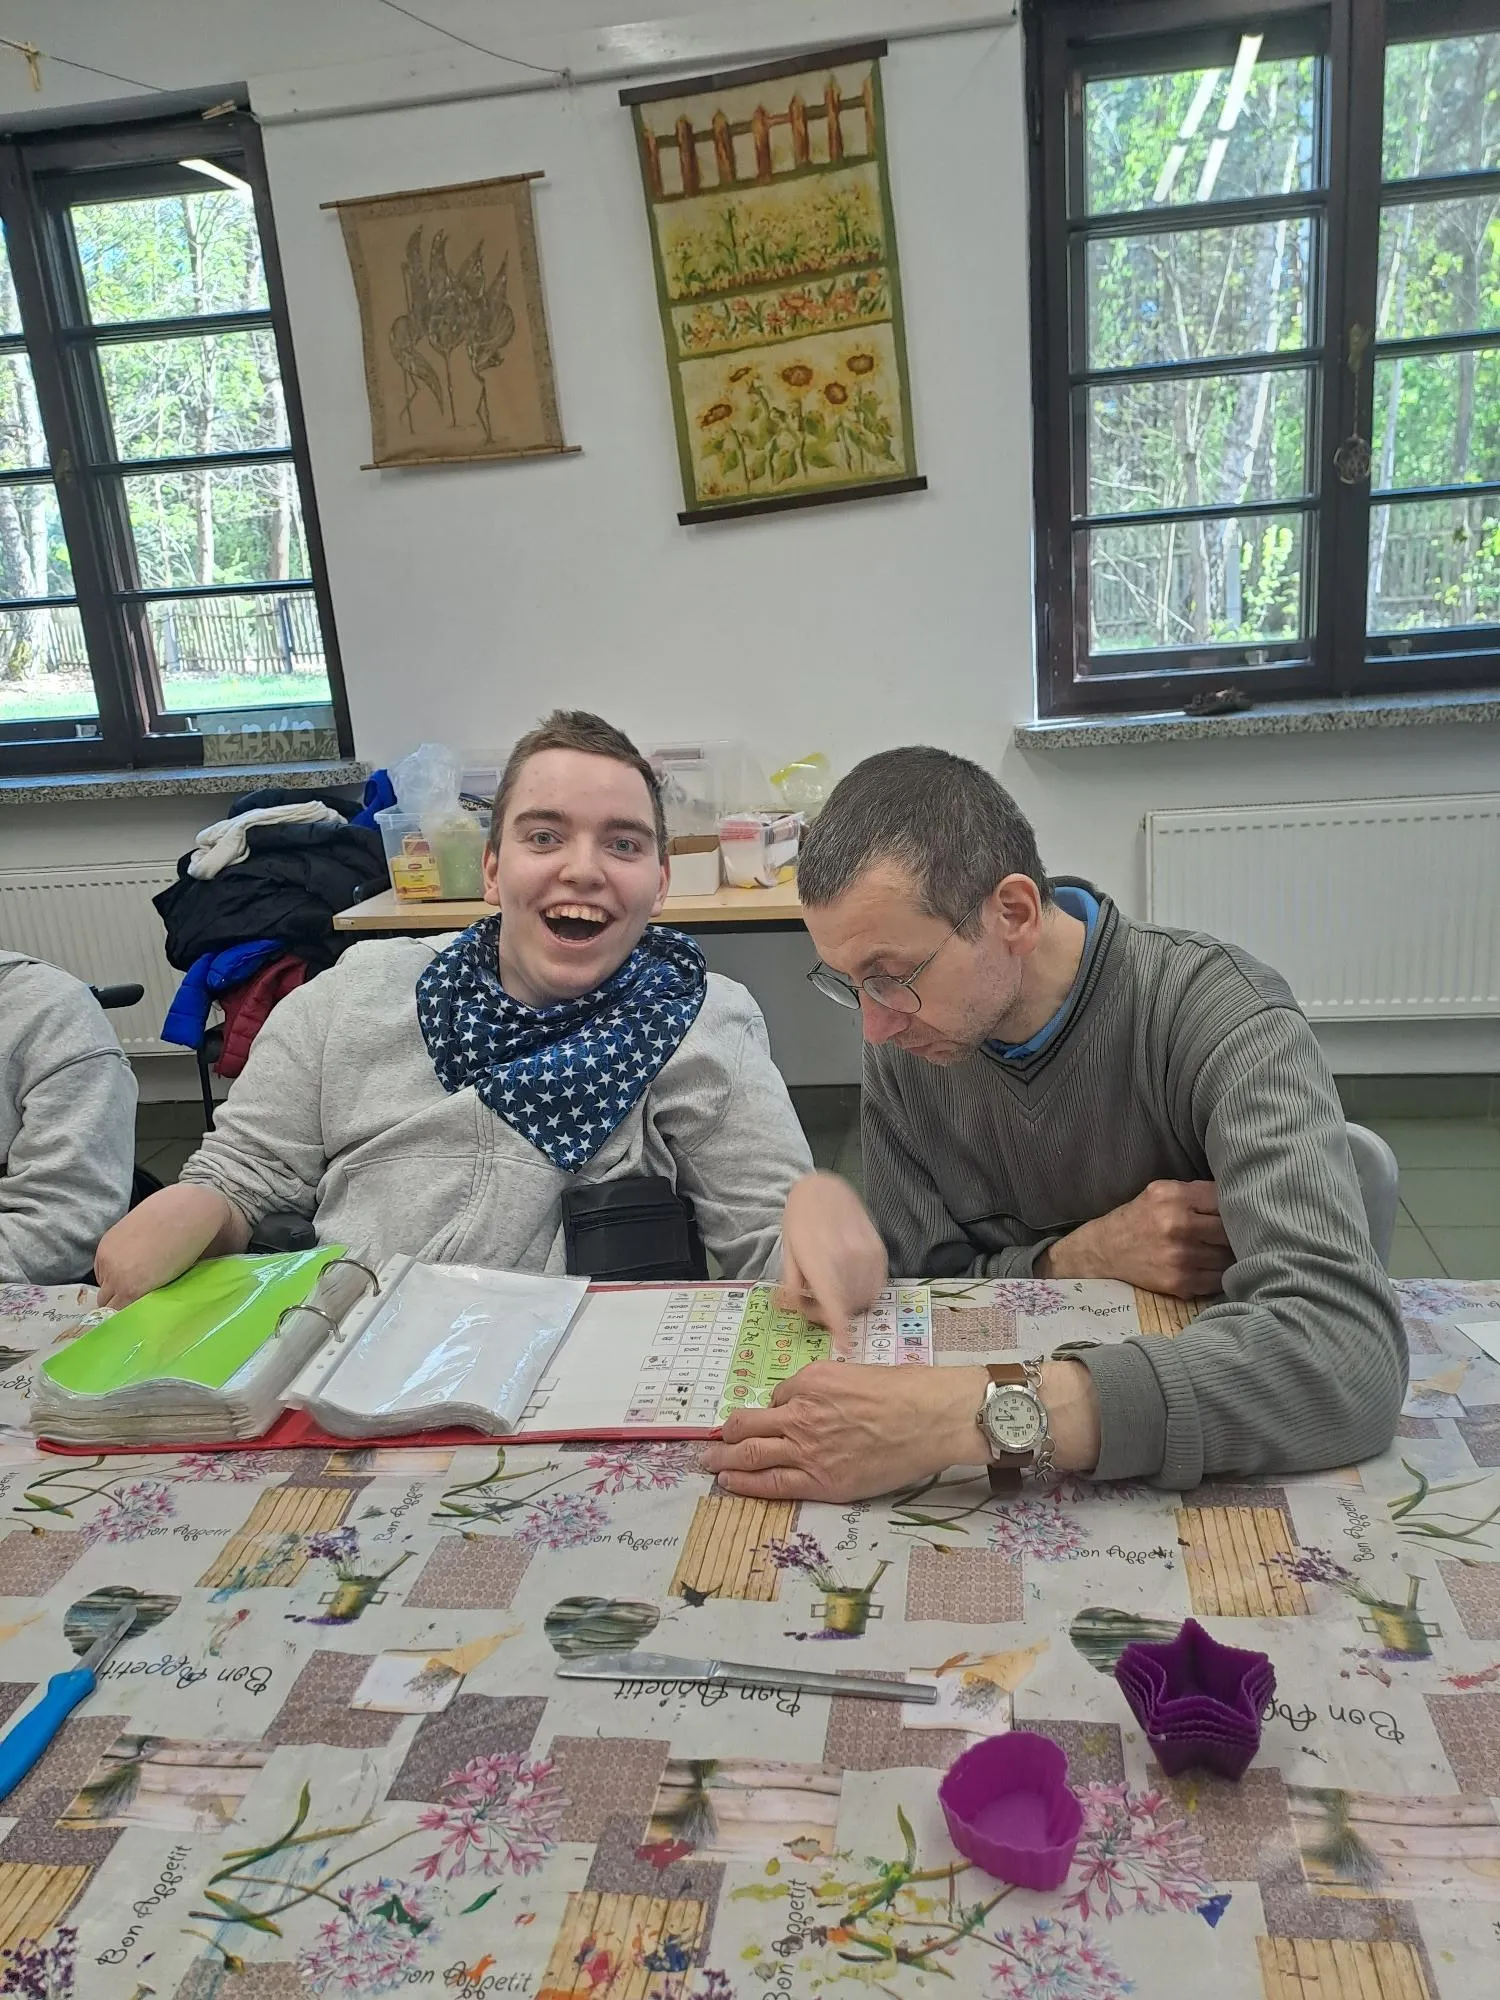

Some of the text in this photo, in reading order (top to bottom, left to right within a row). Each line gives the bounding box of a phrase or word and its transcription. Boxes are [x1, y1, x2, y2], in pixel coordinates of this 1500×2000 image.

[147, 1527, 168, 1536] on
[590, 1530, 680, 1551] on Appetit
[835, 1528, 860, 1551] Bon
[1336, 1496, 1375, 1562] Bon Appetit
[100, 1654, 272, 1696] Bon Appetit
[1328, 1703, 1405, 1744] Bon
[94, 1845, 192, 1965] Bon Appetit
